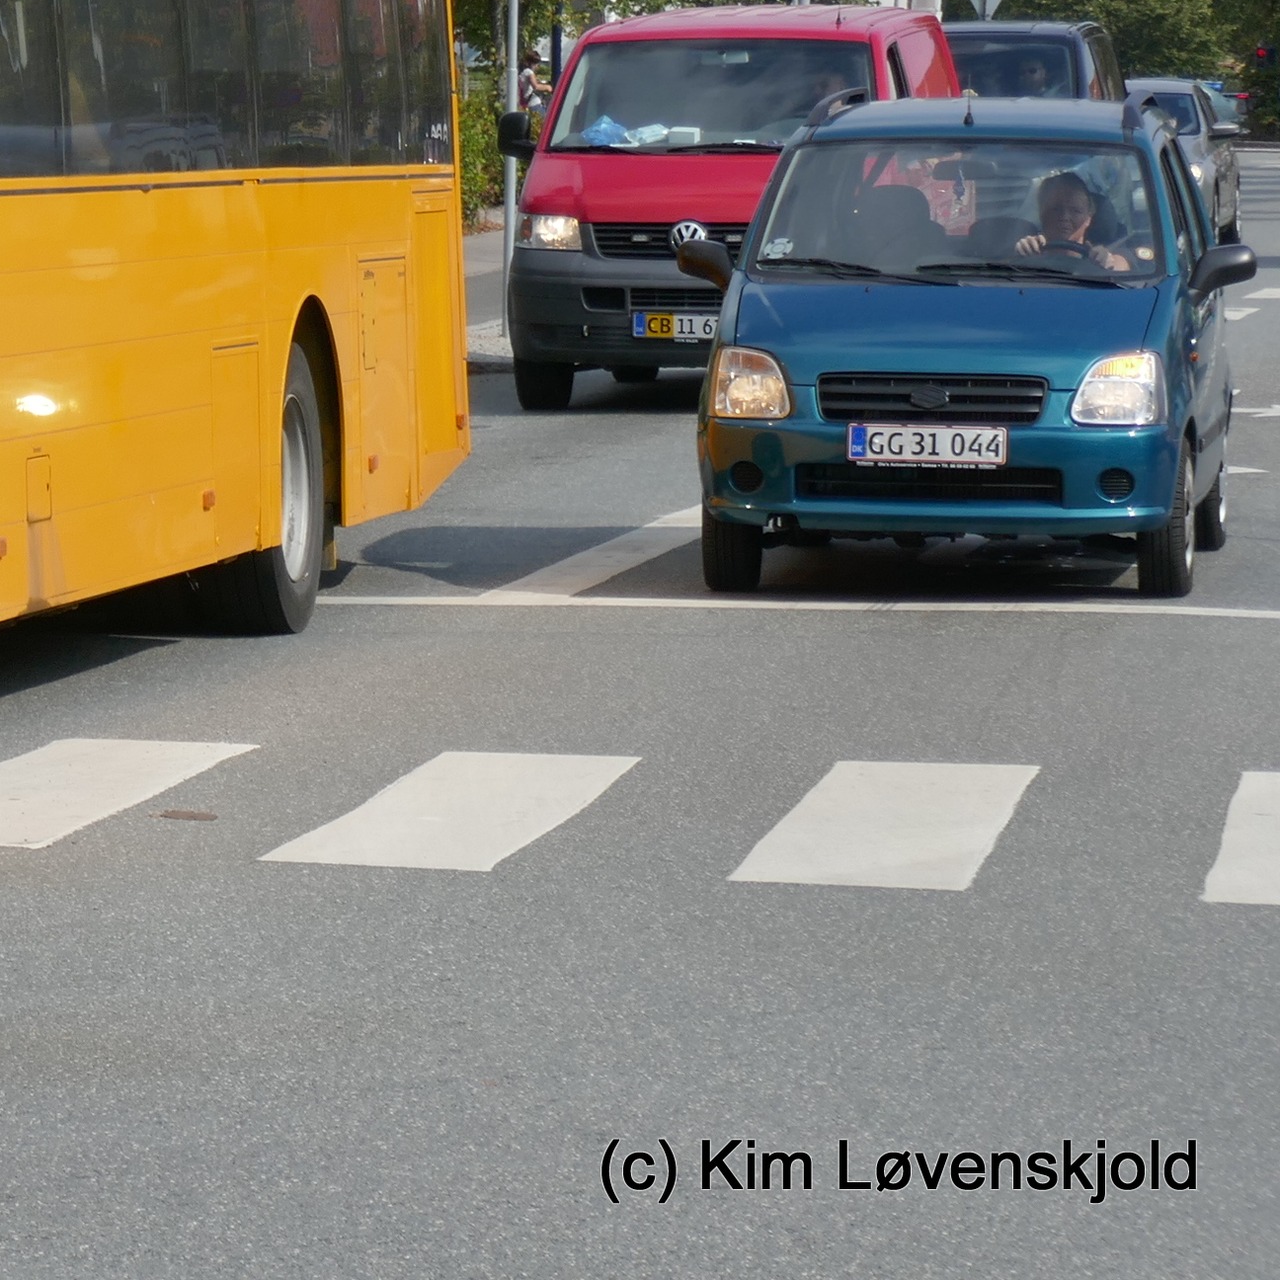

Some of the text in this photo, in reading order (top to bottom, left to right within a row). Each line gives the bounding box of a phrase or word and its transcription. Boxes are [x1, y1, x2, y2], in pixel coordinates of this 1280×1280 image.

[647, 317, 671, 333] CB
[678, 318, 695, 334] 11
[703, 318, 718, 335] 6
[868, 431, 903, 455] GG
[911, 431, 939, 456] 31
[951, 433, 1000, 457] 044
